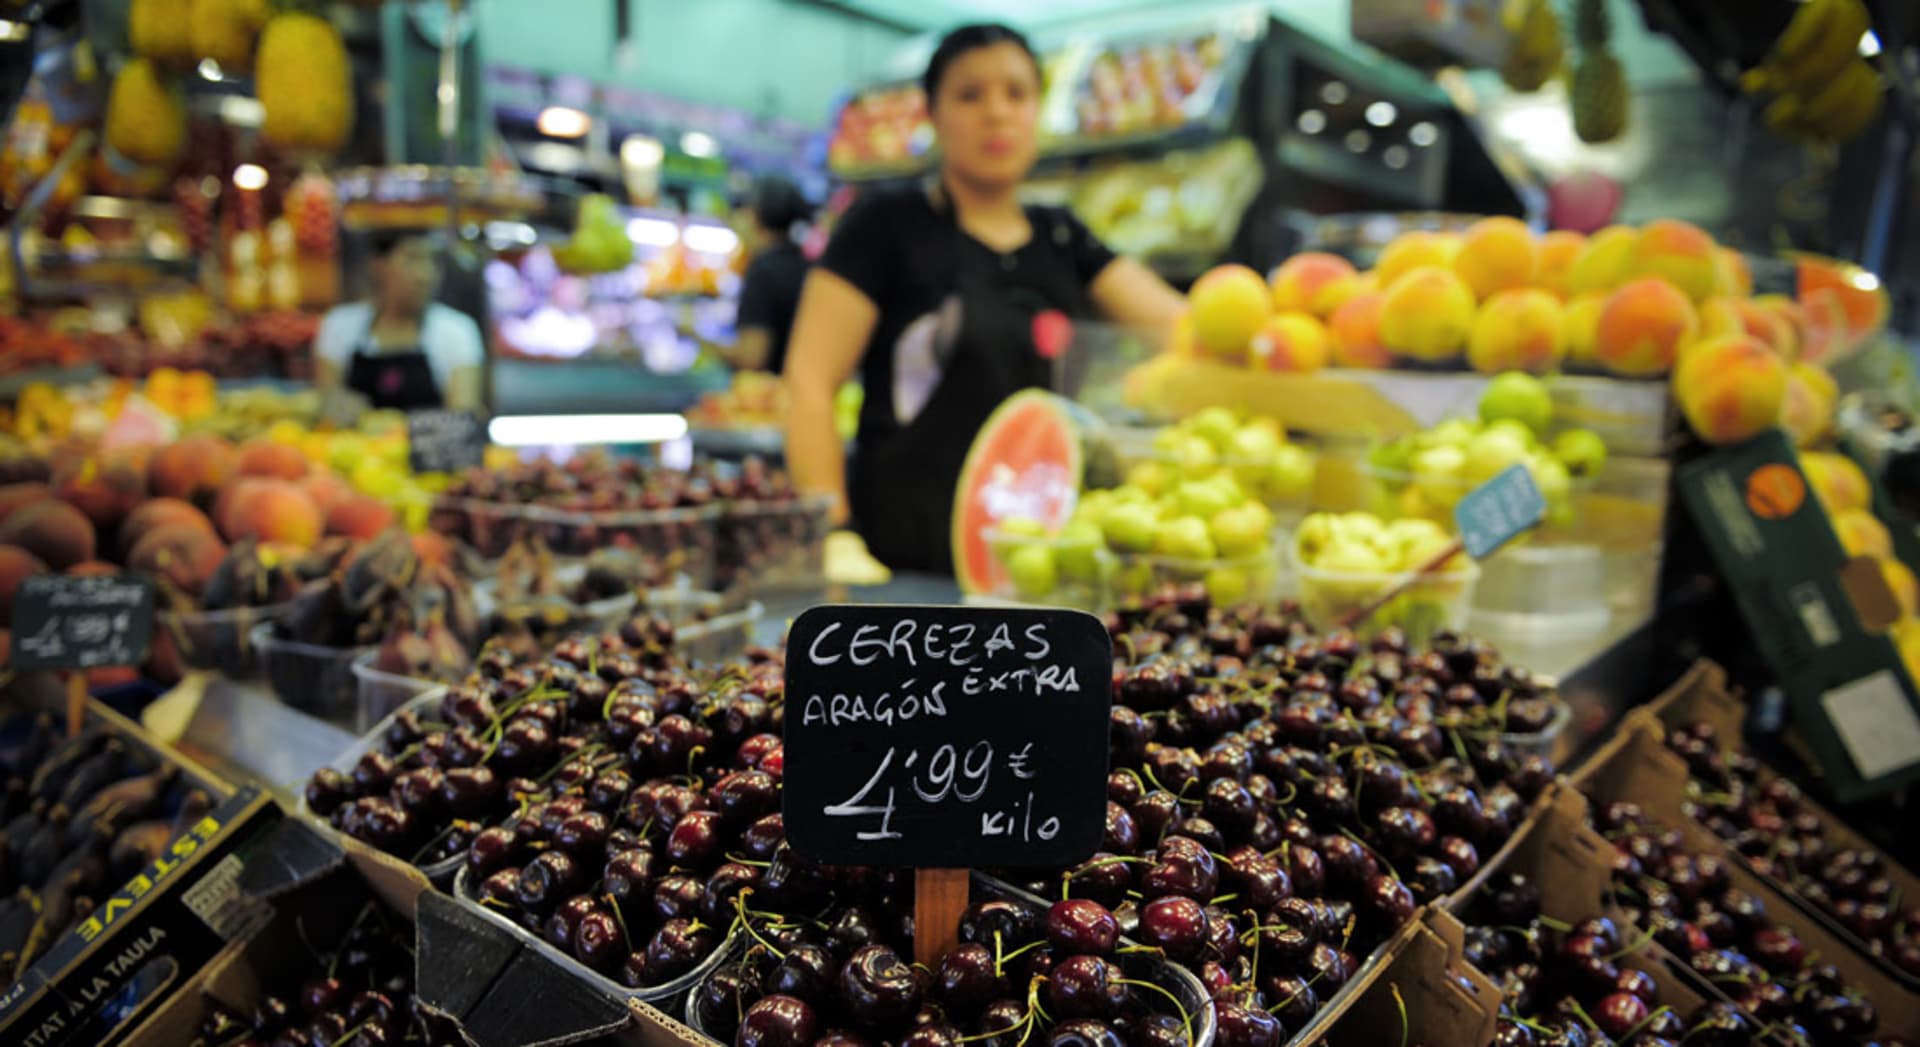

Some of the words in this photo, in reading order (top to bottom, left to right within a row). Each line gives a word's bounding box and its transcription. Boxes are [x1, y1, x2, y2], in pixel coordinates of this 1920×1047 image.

[808, 619, 1051, 666] CEREZAS
[803, 678, 948, 727] ARAGÓN
[962, 665, 1081, 696] EXTRA
[1007, 742, 1037, 779] €
[75, 816, 221, 943] ESTEVE
[80, 976, 109, 1001] LA
[104, 926, 167, 976] TAULA
